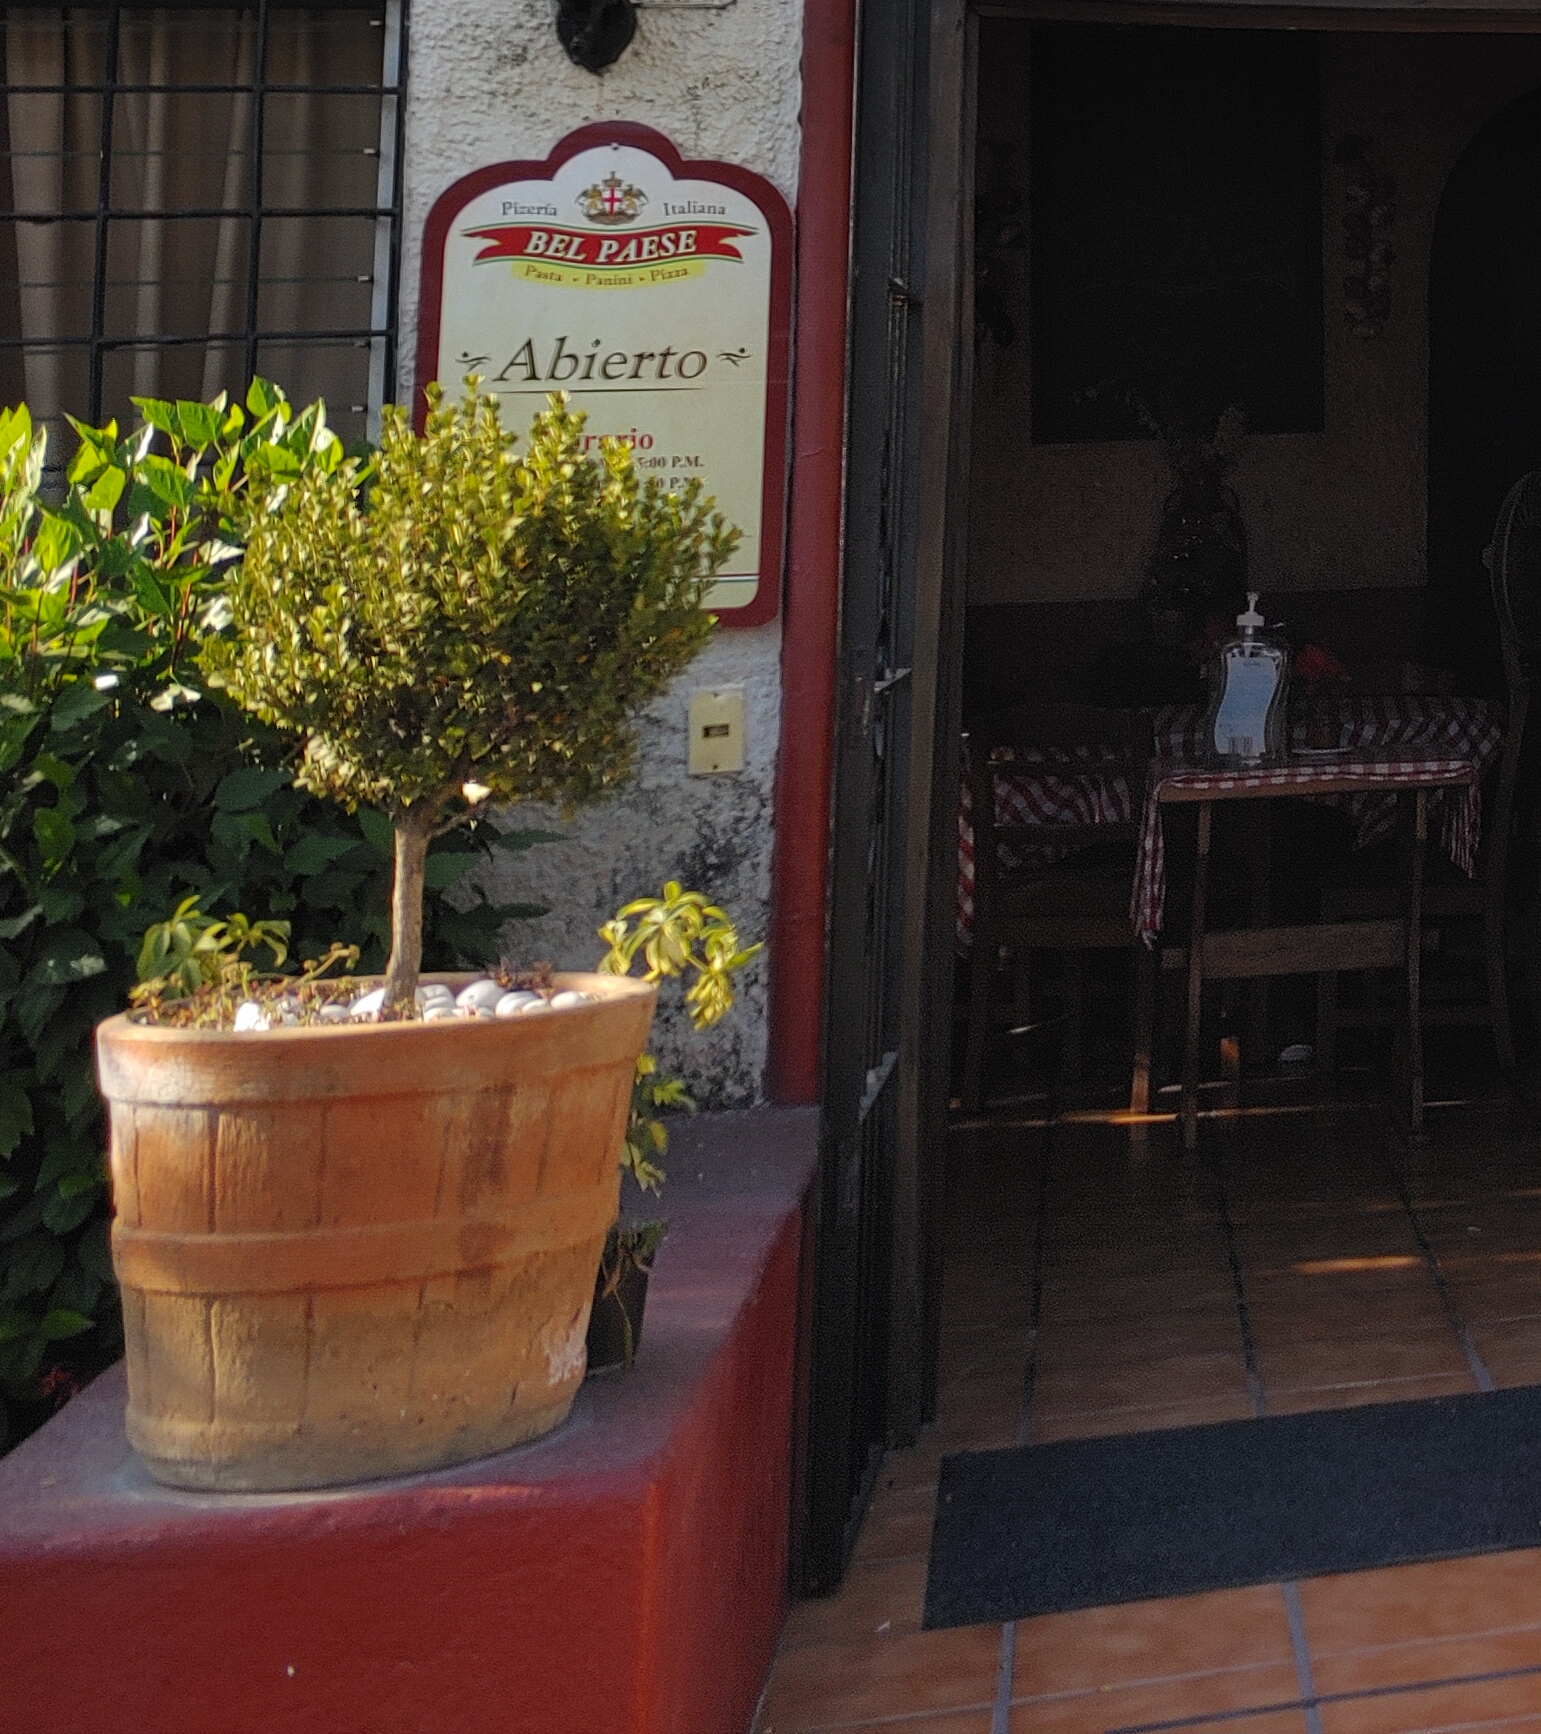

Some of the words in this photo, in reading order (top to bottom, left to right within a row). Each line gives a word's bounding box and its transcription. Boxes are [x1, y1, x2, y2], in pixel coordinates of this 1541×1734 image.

[662, 199, 727, 217] Italiana
[523, 230, 587, 261] BEL
[595, 229, 698, 264] PAESE
[524, 264, 563, 283] Pasta
[585, 272, 634, 287] Panini
[649, 267, 688, 283] Pizza
[492, 335, 708, 383] Abierto
